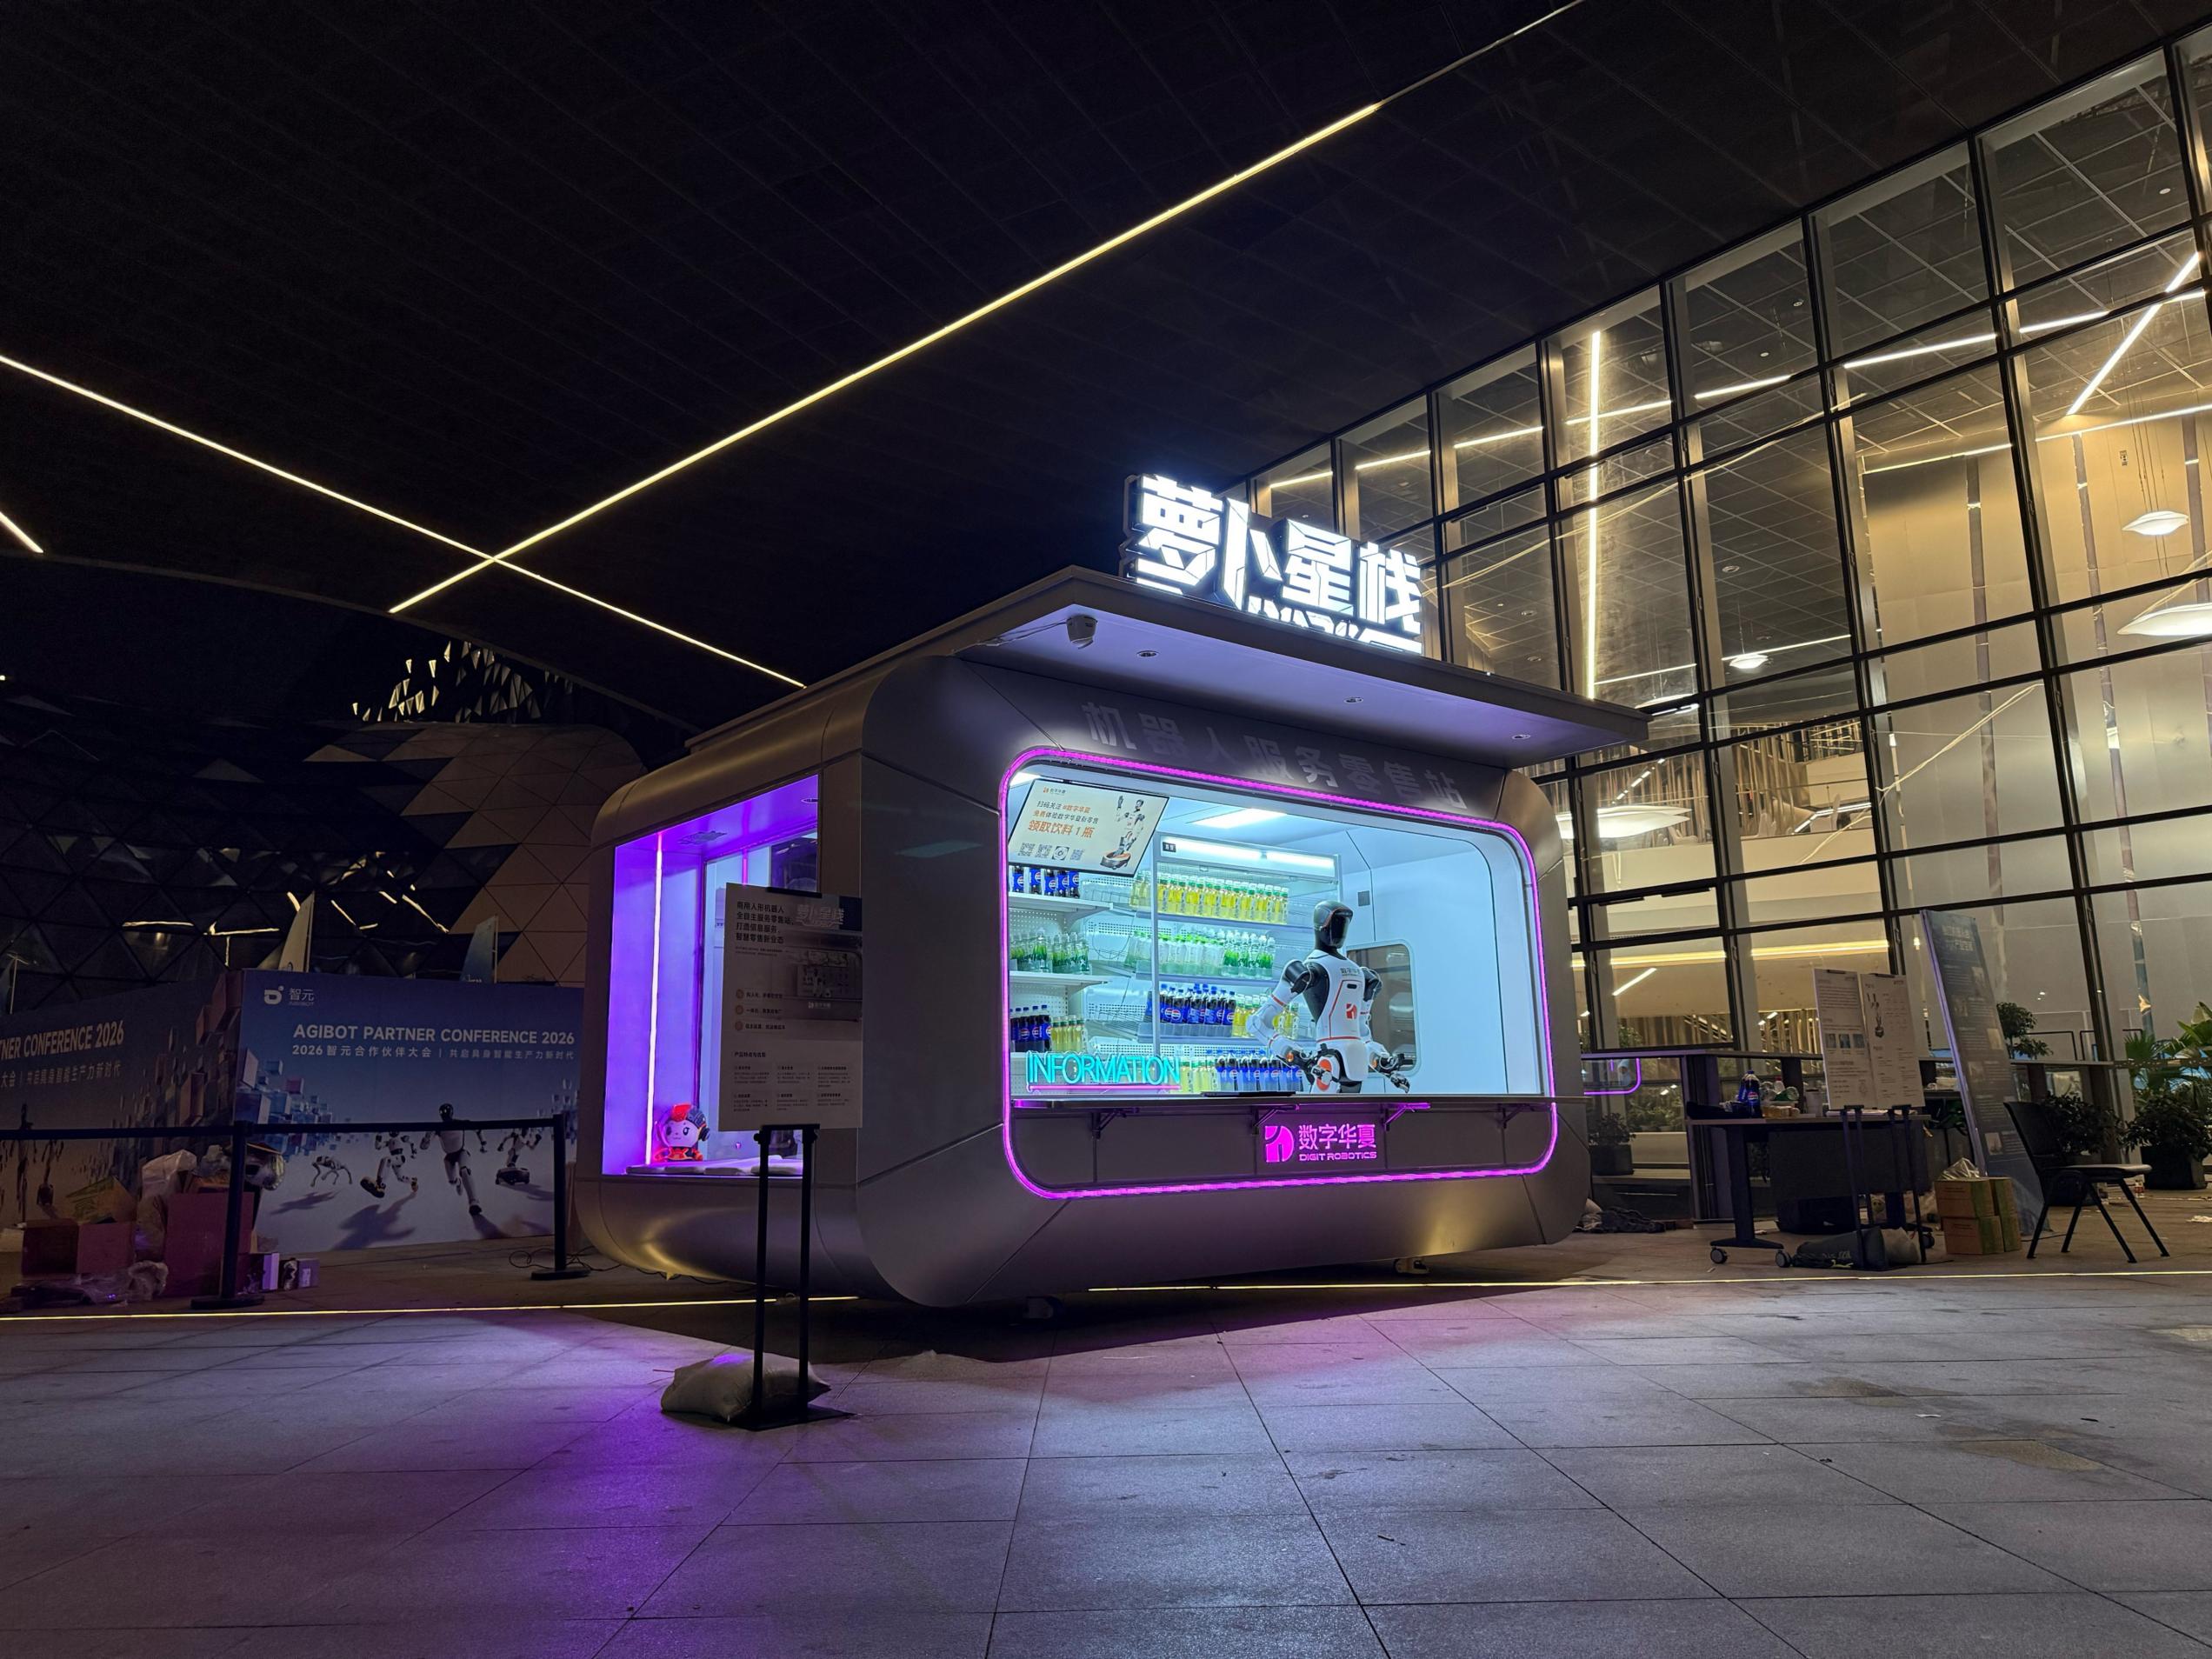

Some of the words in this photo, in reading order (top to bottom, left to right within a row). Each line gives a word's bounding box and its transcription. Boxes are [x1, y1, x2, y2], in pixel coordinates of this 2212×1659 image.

[1135, 474, 1422, 636] 萝卜星栈
[1082, 702, 1469, 810] 机器人服务零售站
[1029, 820, 1073, 836] 领取饮料
[1081, 826, 1095, 838] 瓶
[289, 987, 314, 1002] 智元
[23, 1025, 93, 1058] CONFERENCE
[95, 1020, 125, 1049] 2026
[293, 1024, 357, 1040] AGIBOT
[363, 1026, 436, 1042] PARTNER
[441, 1029, 537, 1044] CONFERENCE
[542, 1032, 575, 1045] 2026
[292, 1044, 323, 1056] 2026
[326, 1045, 432, 1058] 智元合作伙伴大会
[1027, 1051, 1181, 1085] INFORMATION
[1298, 1123, 1377, 1150] 数字华夏
[1299, 1152, 1326, 1162] DIGIT
[1327, 1151, 1377, 1161] ROBOTICS
